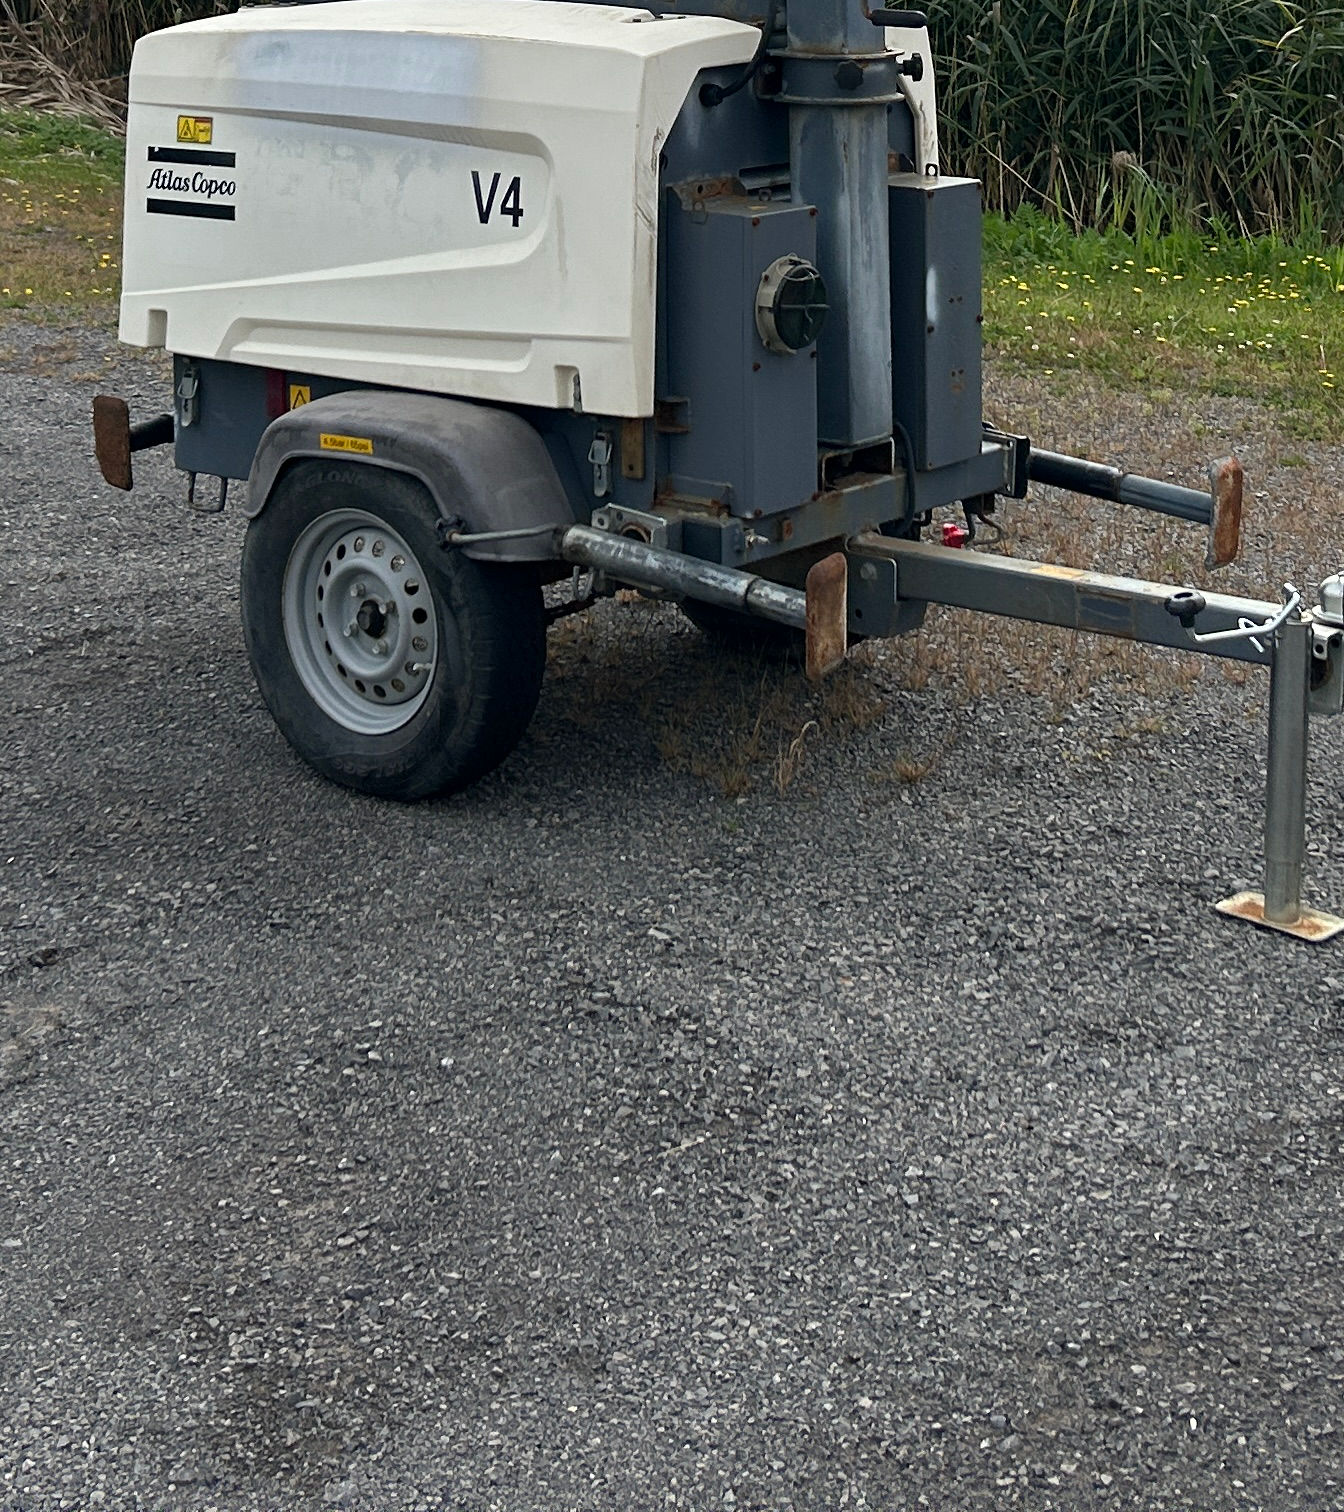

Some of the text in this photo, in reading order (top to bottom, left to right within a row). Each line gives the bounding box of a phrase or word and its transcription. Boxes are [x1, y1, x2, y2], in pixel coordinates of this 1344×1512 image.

[146, 168, 236, 199] Atlas Copco
[470, 170, 524, 228] V4
